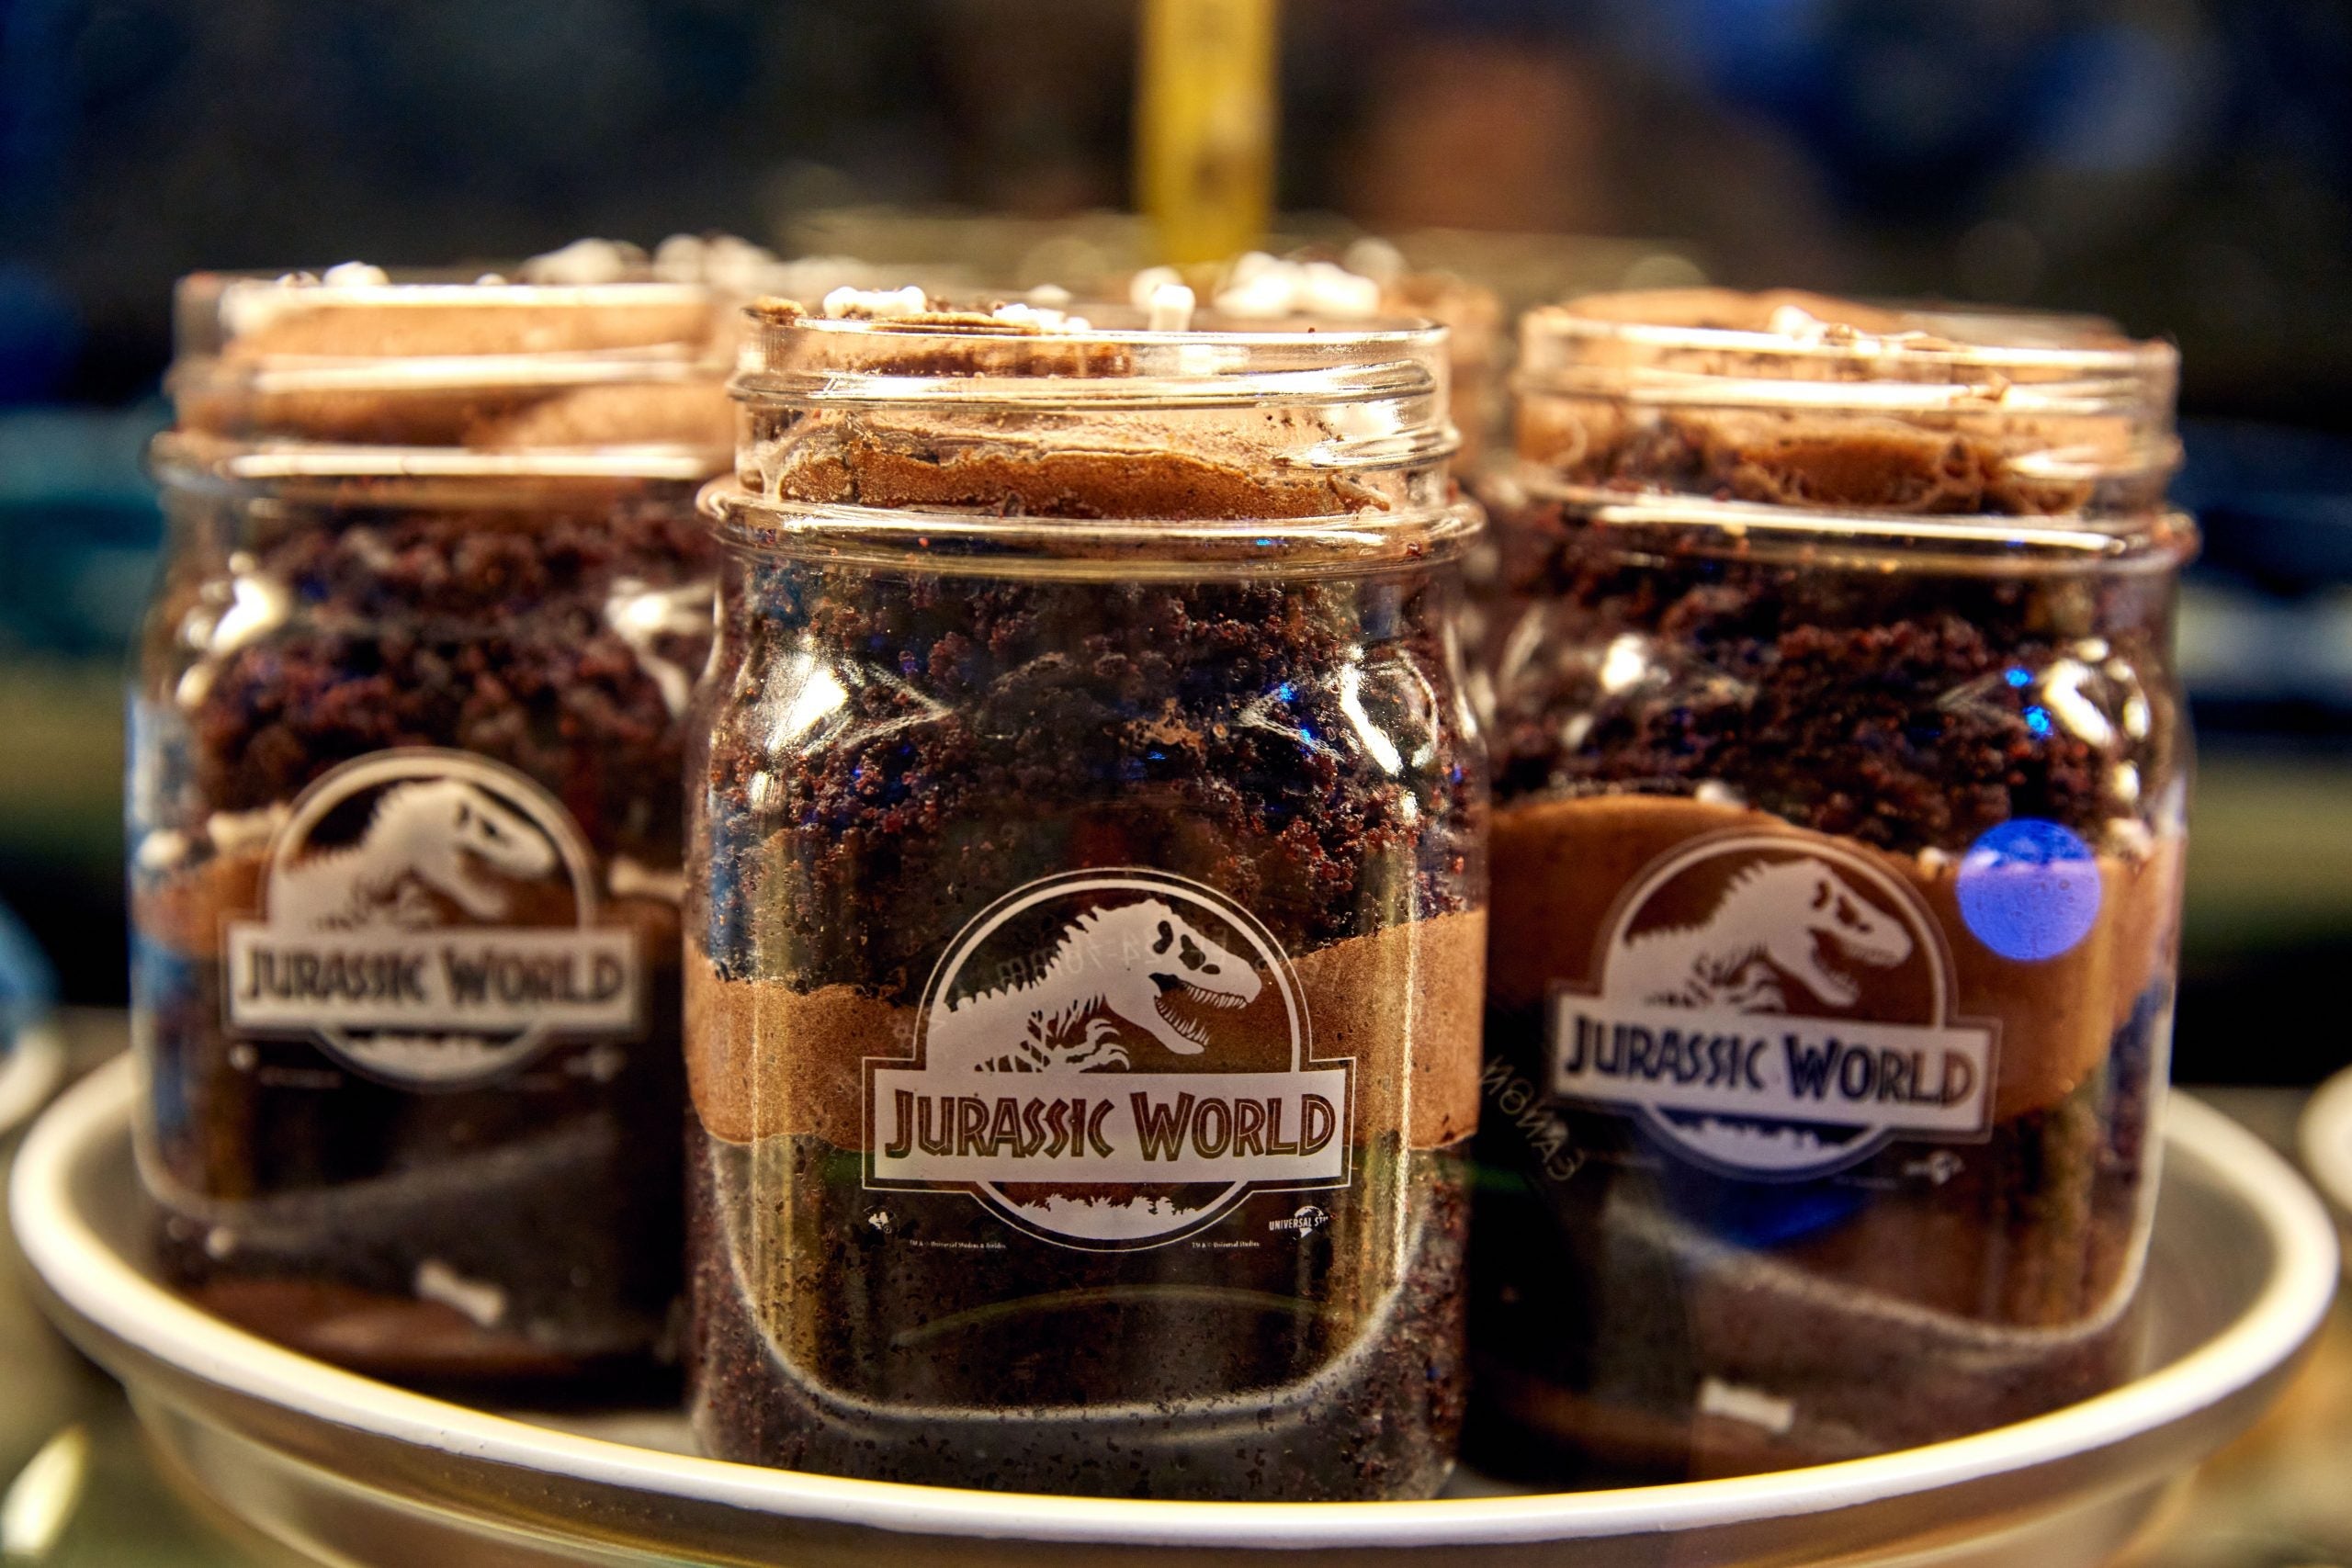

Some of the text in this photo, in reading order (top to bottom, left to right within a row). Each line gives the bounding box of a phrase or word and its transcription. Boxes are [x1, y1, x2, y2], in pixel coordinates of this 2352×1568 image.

[243, 947, 623, 1005] JURASSIC WORLD
[1566, 1015, 1977, 1111] JURASSIC WORLD
[885, 1089, 1336, 1161] JURASSIC WORLD
[1269, 1217, 1312, 1231] UNIVERSAL
